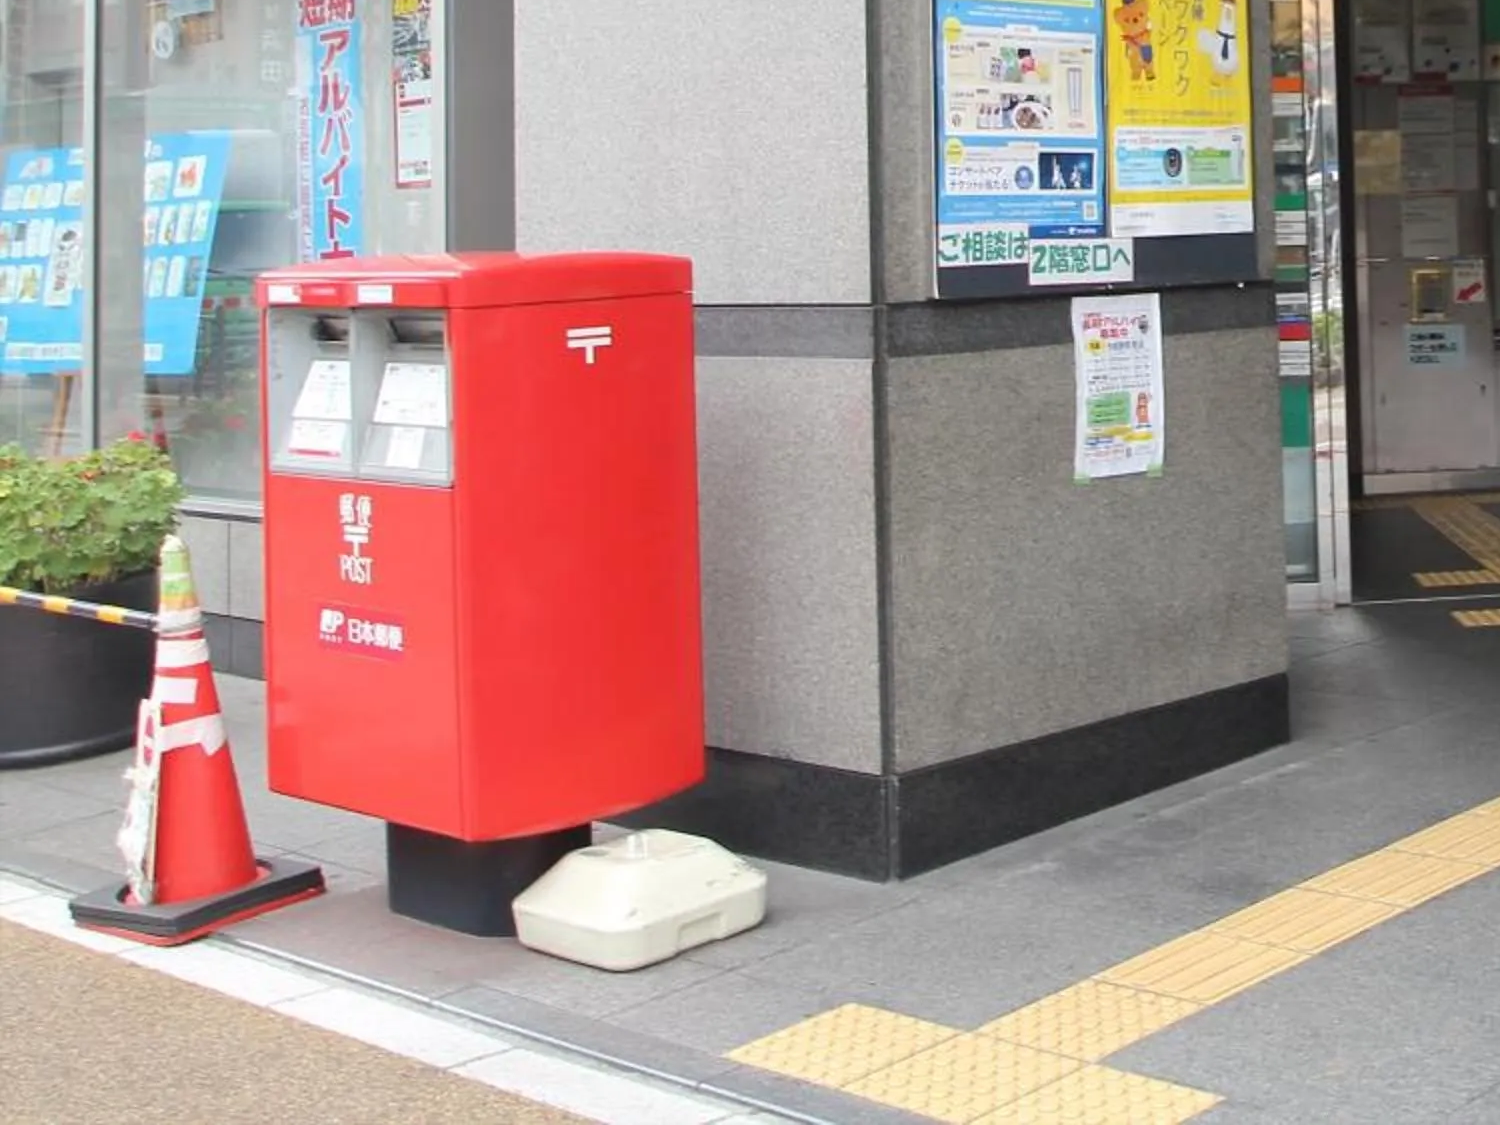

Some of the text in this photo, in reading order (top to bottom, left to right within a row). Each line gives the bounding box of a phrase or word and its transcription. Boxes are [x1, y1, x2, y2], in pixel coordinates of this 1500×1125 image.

[939, 233, 1028, 263] ご相談は
[1031, 244, 1132, 275] 2階窓口へ
[339, 493, 373, 529] 郵便
[339, 554, 373, 585] POST
[347, 617, 405, 652] 日本郵便
